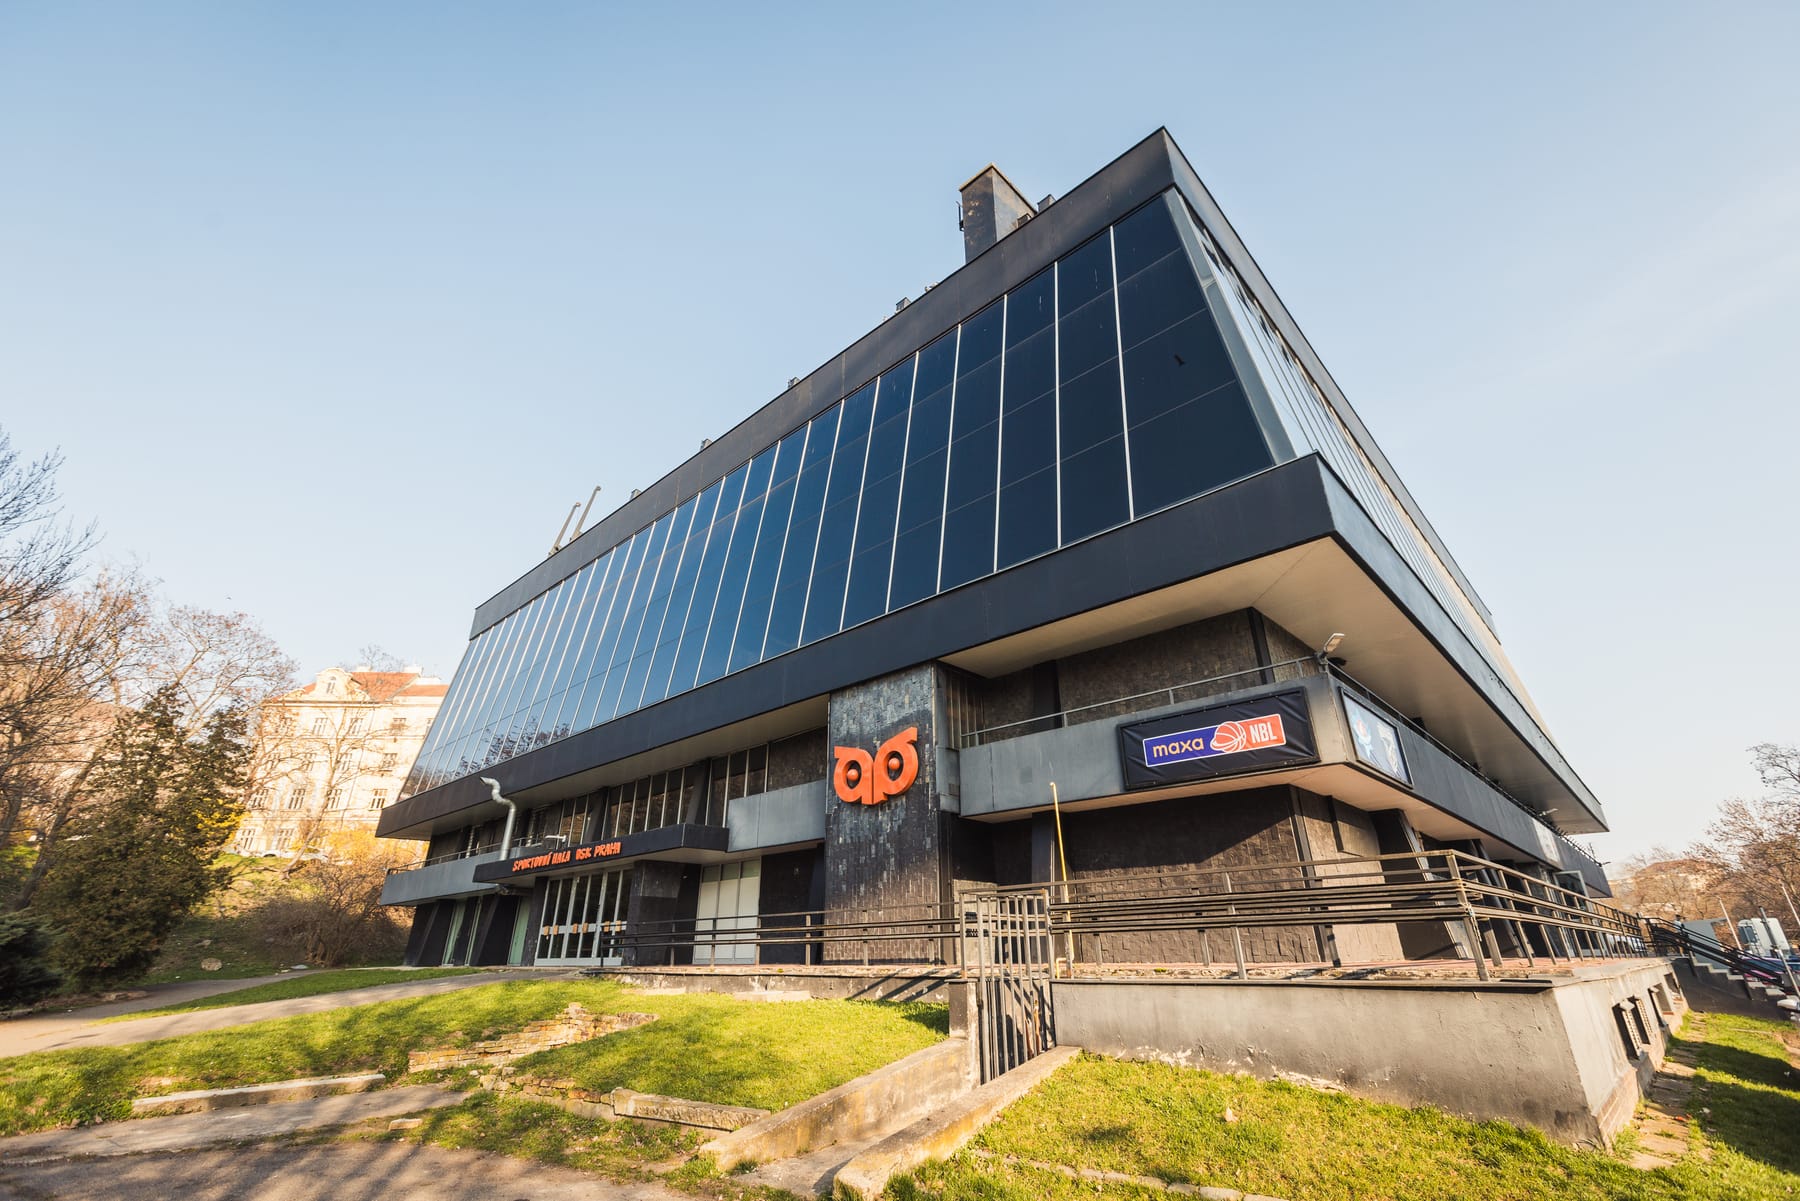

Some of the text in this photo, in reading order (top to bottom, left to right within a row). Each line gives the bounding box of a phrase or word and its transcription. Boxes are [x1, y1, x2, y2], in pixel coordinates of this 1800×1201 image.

[1153, 722, 1277, 758] maxa NBL
[593, 842, 622, 858] PRAHA
